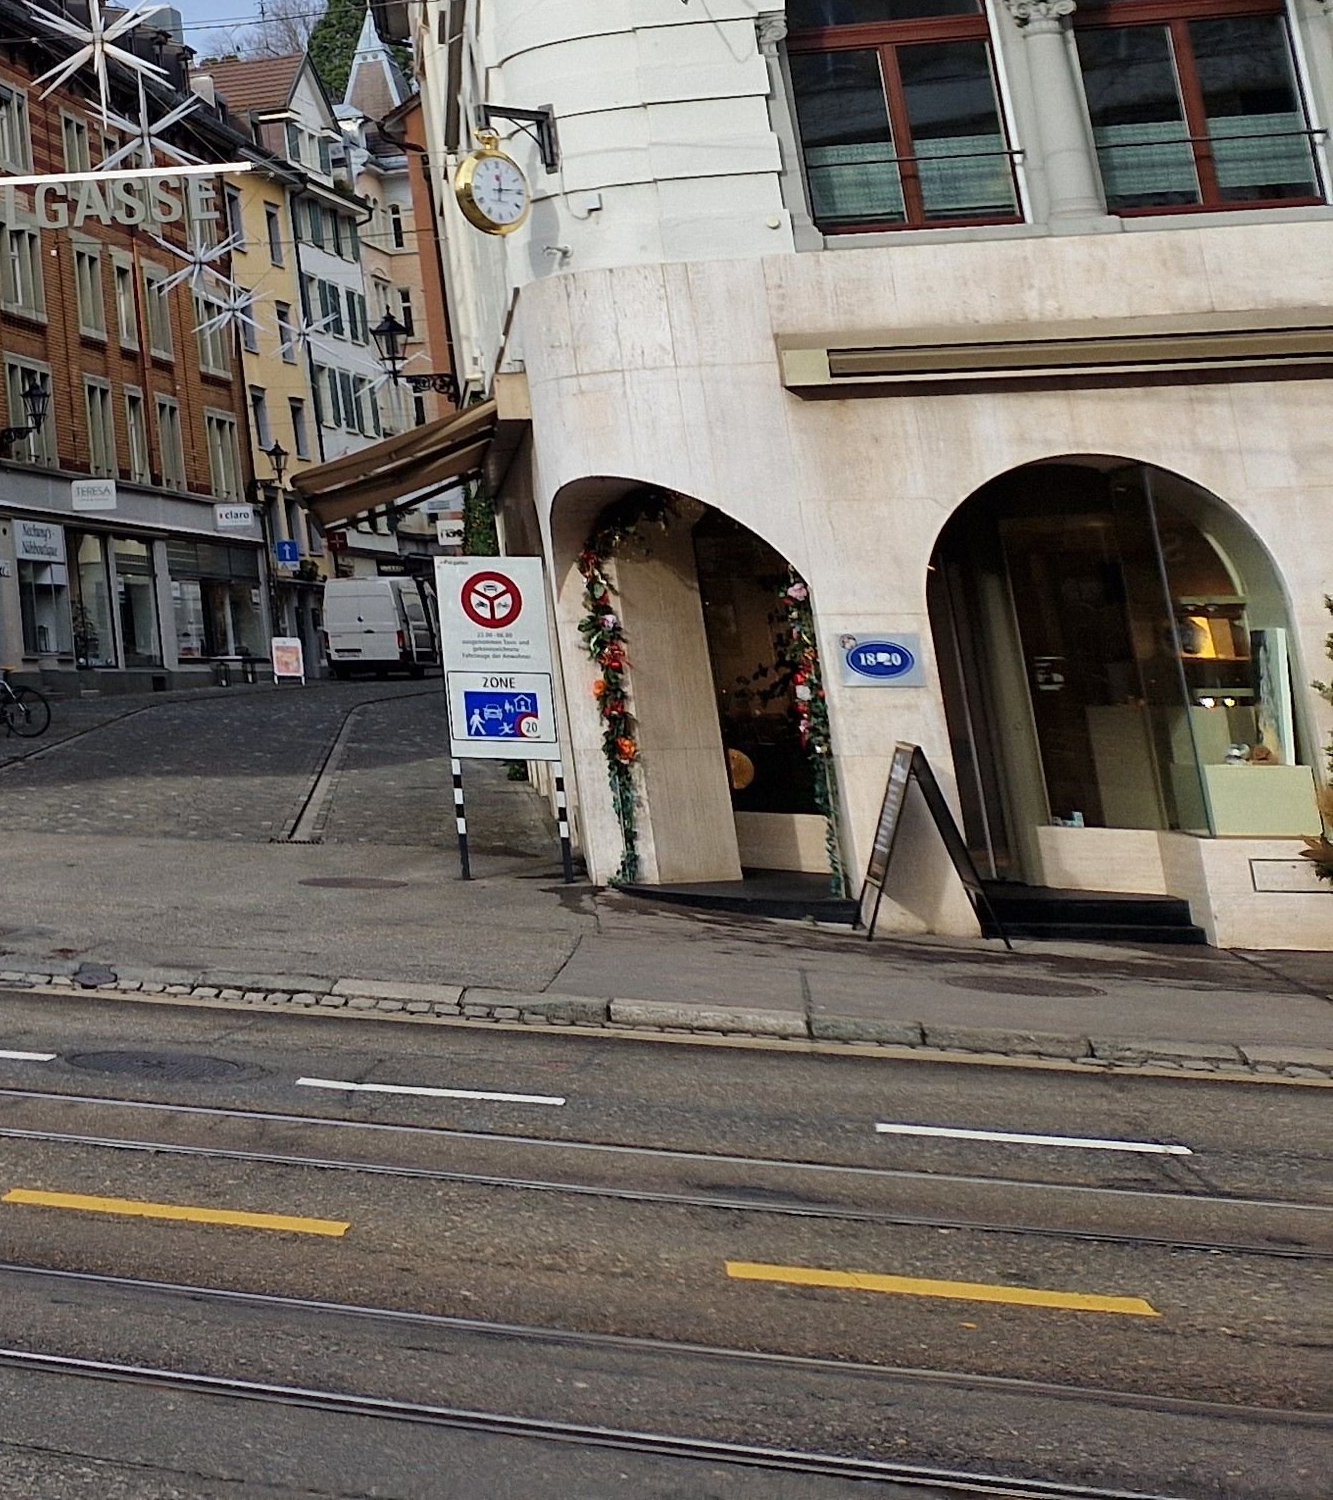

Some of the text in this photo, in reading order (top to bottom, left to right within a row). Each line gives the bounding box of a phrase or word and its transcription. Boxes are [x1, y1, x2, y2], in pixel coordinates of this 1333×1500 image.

[75, 486, 111, 497] TERESA
[225, 510, 250, 519] claro
[482, 677, 516, 689] ZONE
[525, 722, 538, 733] 20
